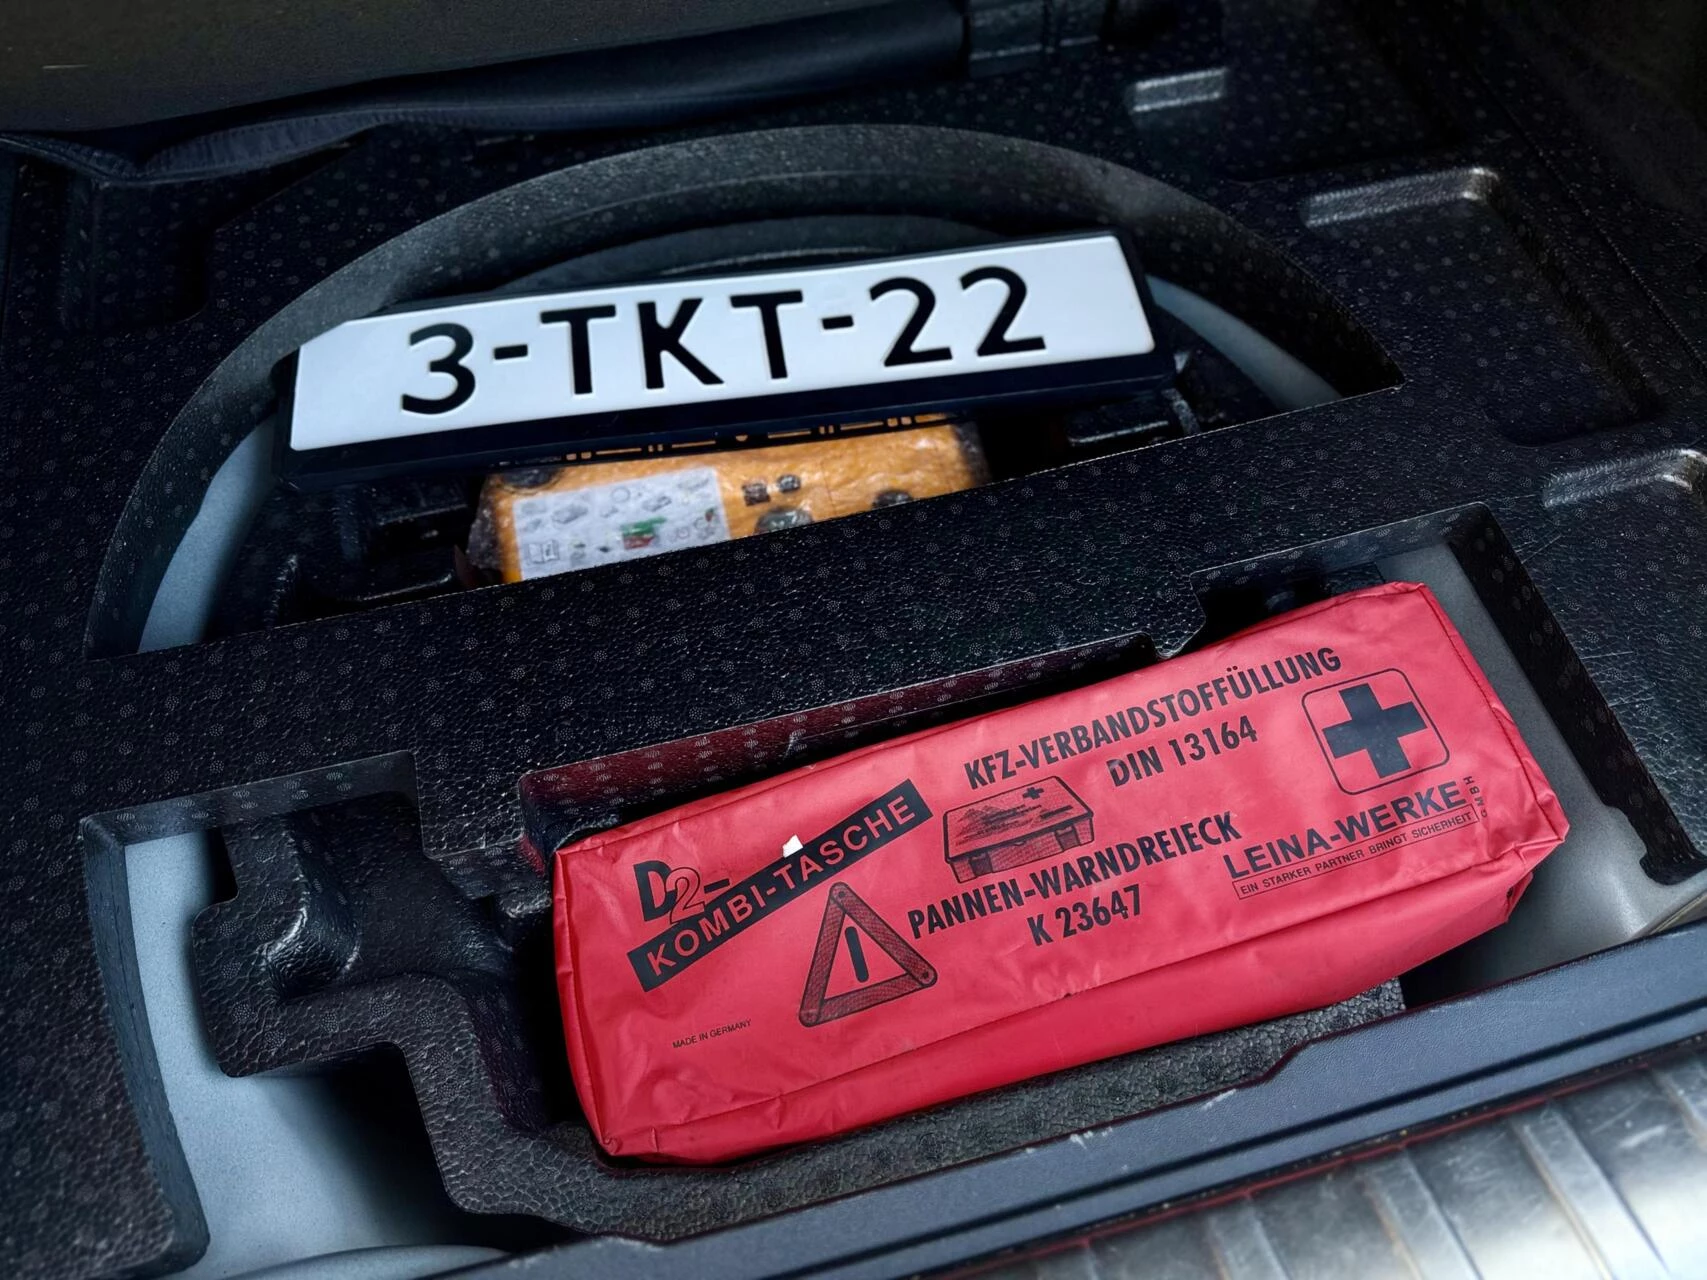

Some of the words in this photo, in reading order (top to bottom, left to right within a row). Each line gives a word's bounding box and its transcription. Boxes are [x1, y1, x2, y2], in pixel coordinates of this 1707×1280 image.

[400, 265, 1047, 415] 3-TKT-22
[965, 647, 1342, 789] KFZ-VERBANDSTOFFÜLLUNG
[1107, 753, 1165, 787] DIN
[1171, 716, 1259, 768] 13164
[907, 811, 1241, 938] PANNEN-WARNDREIECK
[1223, 780, 1467, 879] LEINA-WERKE
[1240, 881, 1259, 895] EIN
[1263, 866, 1312, 888] STARKER
[1315, 849, 1365, 871] PARTNER
[1369, 833, 1408, 854] BRINGT
[1412, 811, 1473, 838] SICHERHEIT
[646, 795, 916, 977] KOMBI-TASCHE
[1027, 913, 1053, 946] K
[1055, 884, 1143, 936] 23647
[672, 1035, 698, 1048] MADE
[699, 1032, 708, 1041] IN
[709, 1019, 752, 1038] GERMANY
